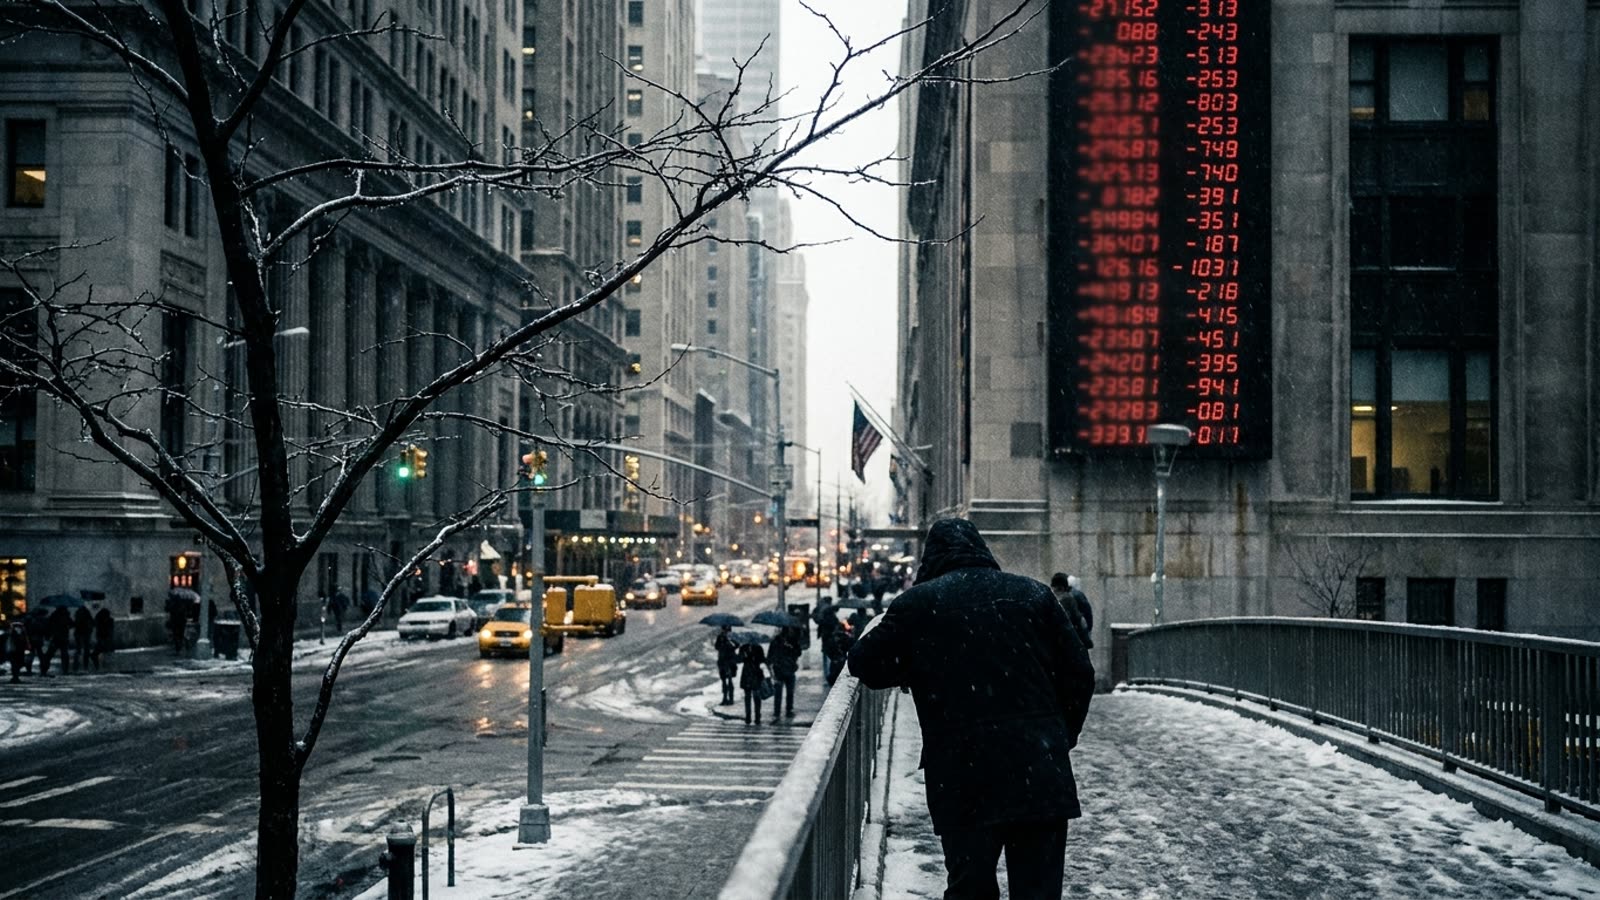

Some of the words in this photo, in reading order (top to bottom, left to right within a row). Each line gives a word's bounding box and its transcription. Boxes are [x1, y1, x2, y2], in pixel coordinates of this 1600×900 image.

[1187, 0, 1237, 17] -313
[1187, 23, 1237, 40] -243
[1187, 46, 1238, 64] -513
[1187, 70, 1237, 87] -253
[1187, 94, 1238, 111] -803
[1187, 117, 1238, 134] -253
[1187, 141, 1238, 158] -749
[1187, 164, 1238, 181] -740
[1187, 188, 1238, 205] -391
[1187, 212, 1237, 230] -351
[1187, 235, 1237, 253] -187
[1173, 259, 1237, 276] -1031
[1187, 283, 1237, 300] -218
[1187, 307, 1236, 324] -415
[1187, 330, 1237, 348] -451
[1187, 354, 1236, 372] -395
[1187, 378, 1238, 395] -941
[1187, 402, 1238, 420] -081
[1079, 424, 1146, 444] -3391
